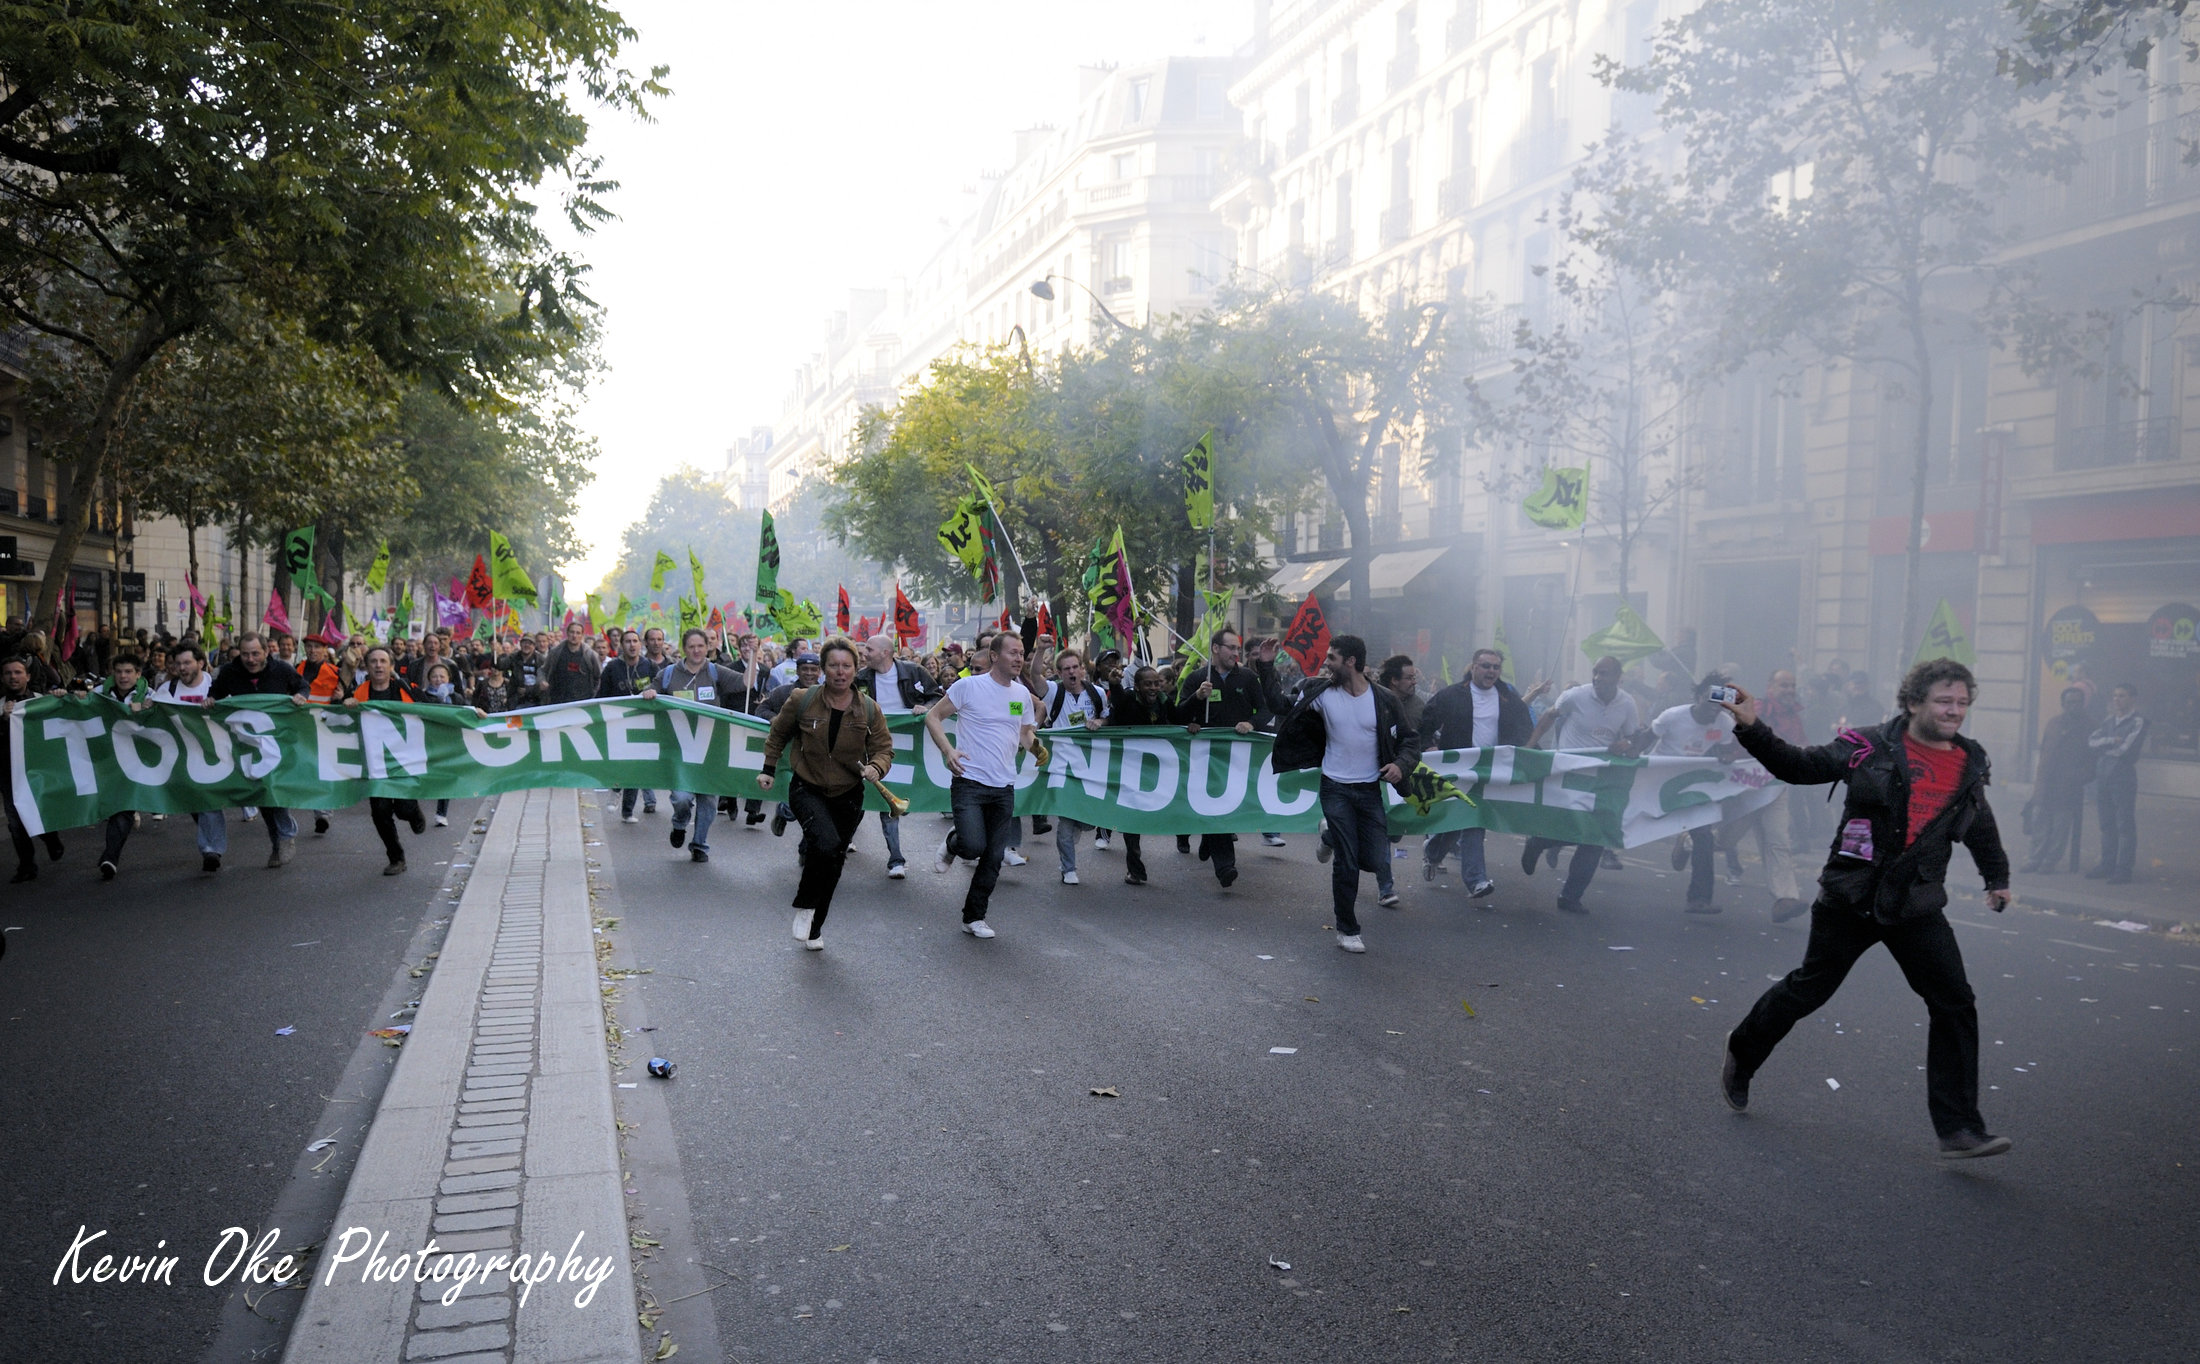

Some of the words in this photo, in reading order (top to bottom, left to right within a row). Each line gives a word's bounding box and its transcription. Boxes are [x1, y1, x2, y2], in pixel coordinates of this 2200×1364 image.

[43, 709, 282, 796] TOUS
[309, 708, 428, 782] EN
[461, 703, 768, 771] GREVE
